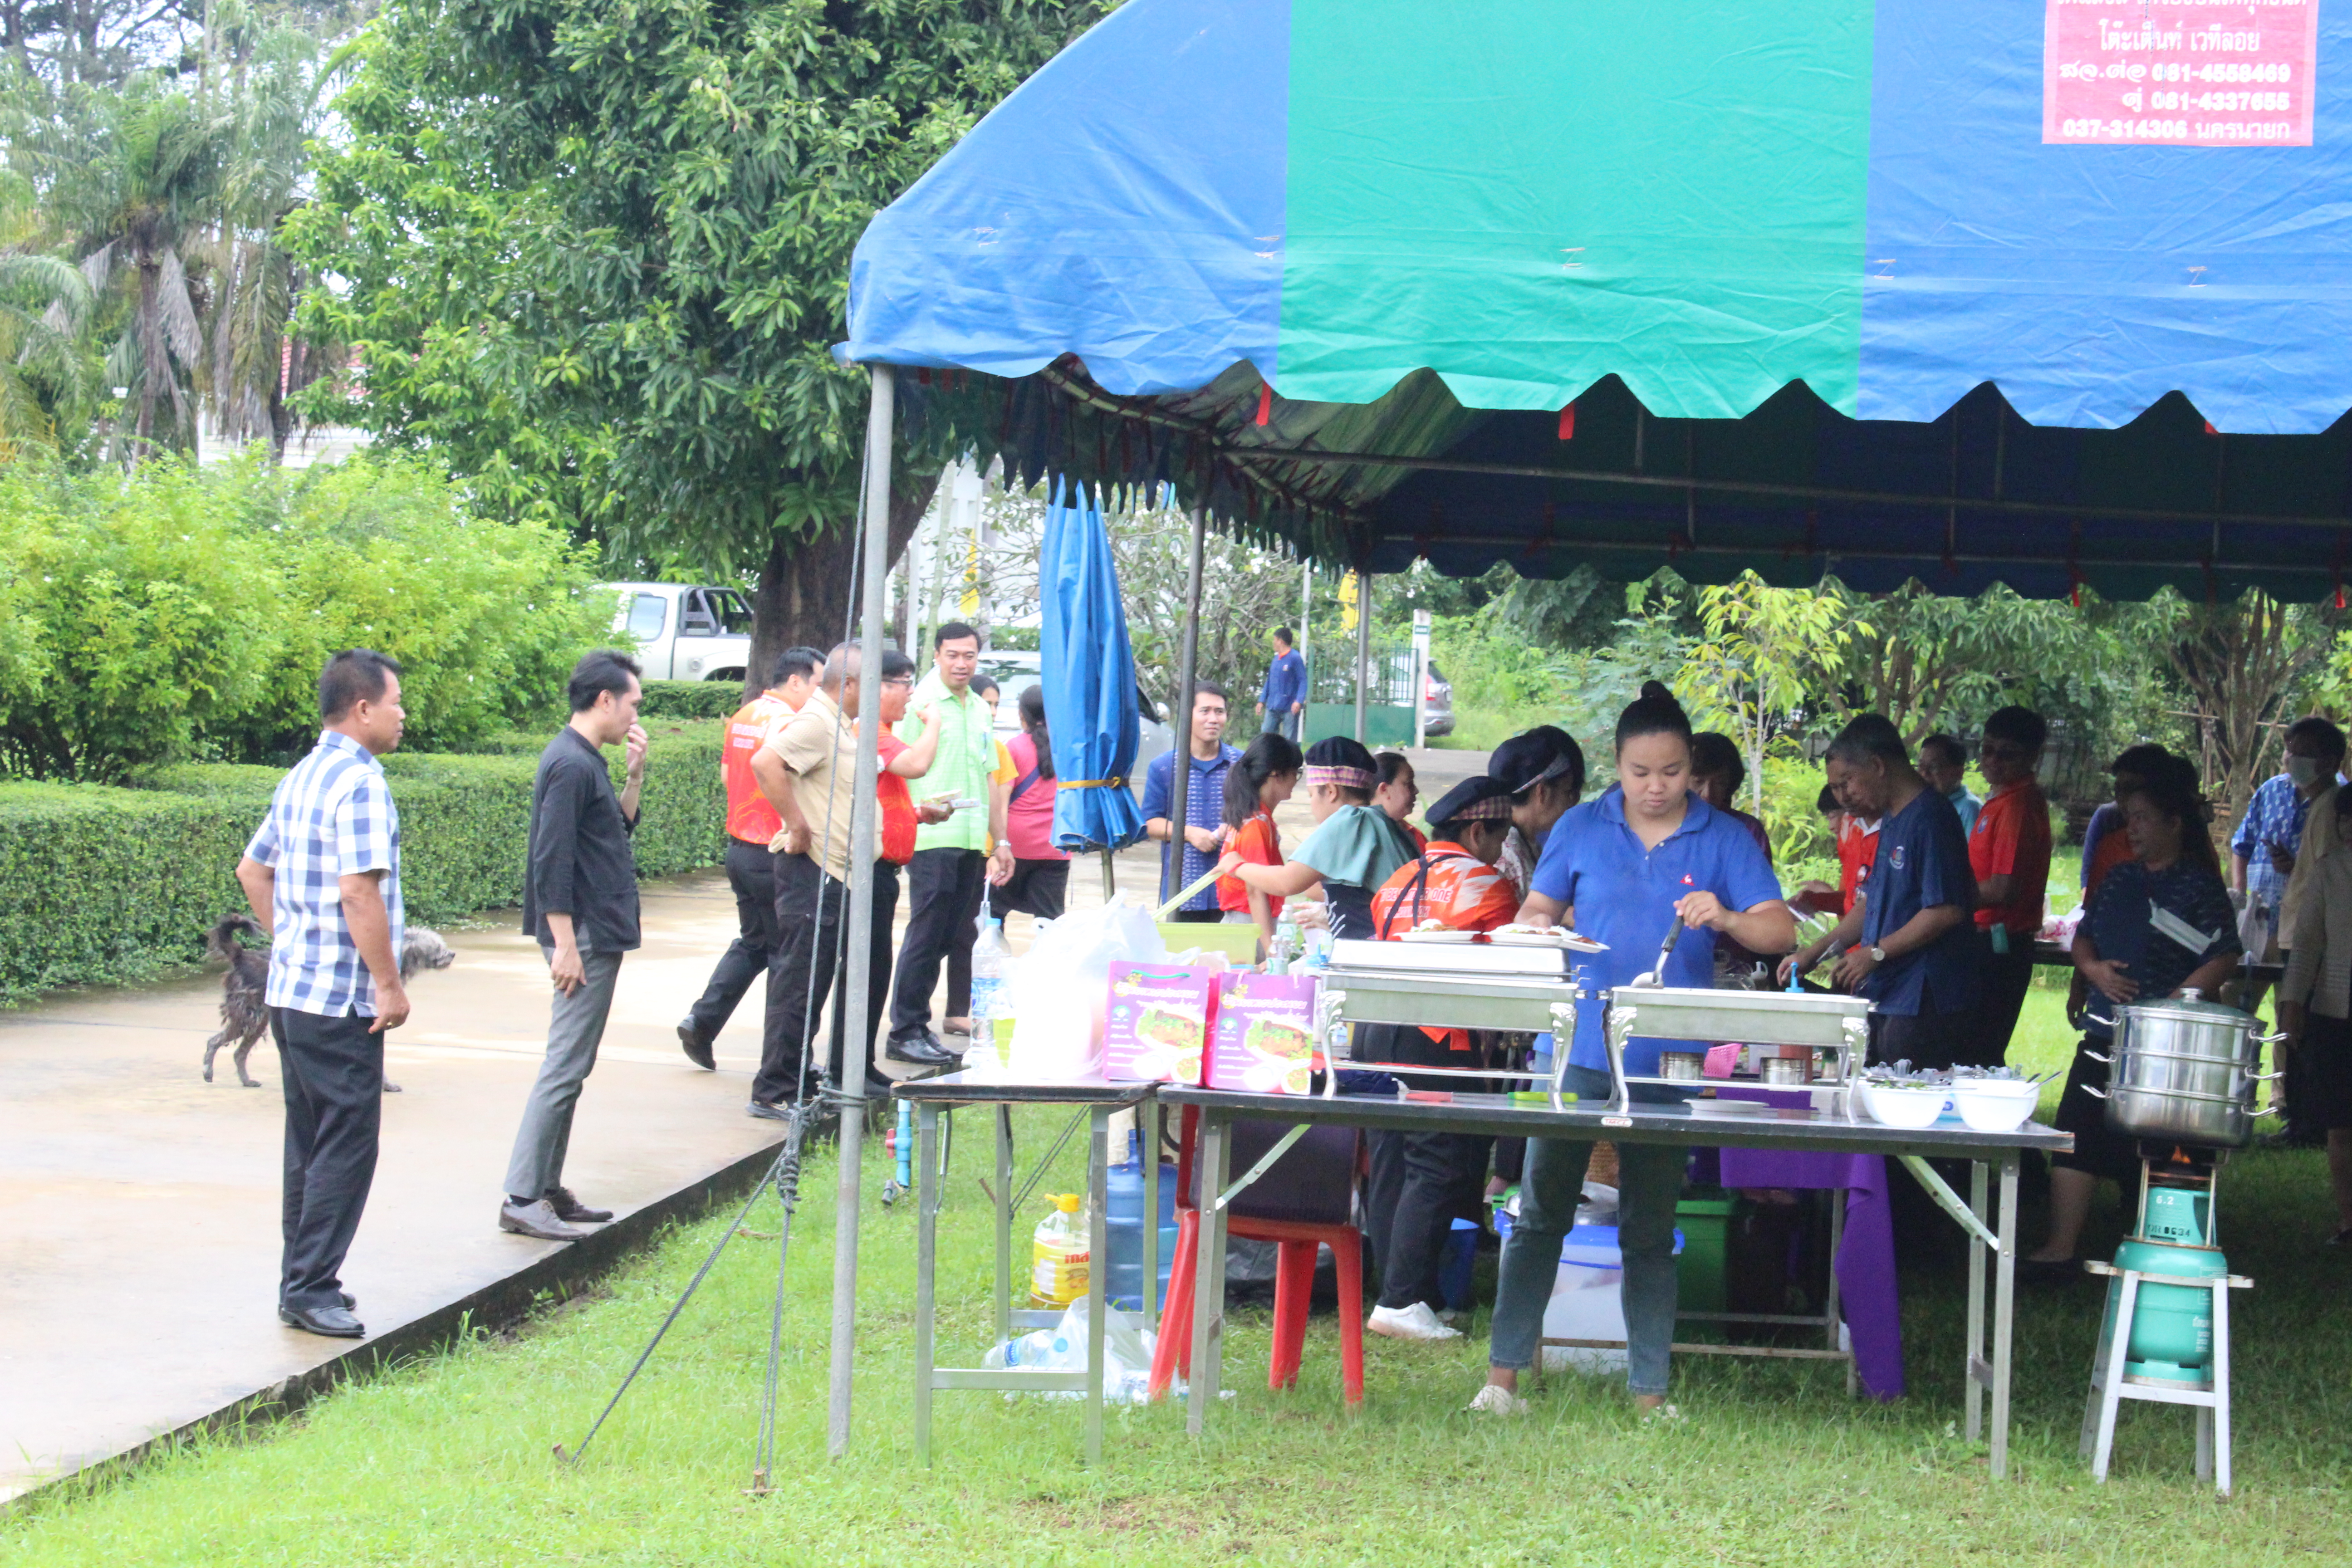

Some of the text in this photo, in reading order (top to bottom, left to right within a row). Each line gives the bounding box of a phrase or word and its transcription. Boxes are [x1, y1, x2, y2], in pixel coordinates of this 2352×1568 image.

[2190, 23, 2260, 52] เวทีลอย
[2151, 63, 2291, 83] 081-4558469
[2151, 91, 2290, 111] 081-4337655
[2062, 118, 2290, 140] 037-314306 นครนายก
[1431, 887, 1454, 903] ONE
[2156, 1195, 2174, 1205] 6.2
